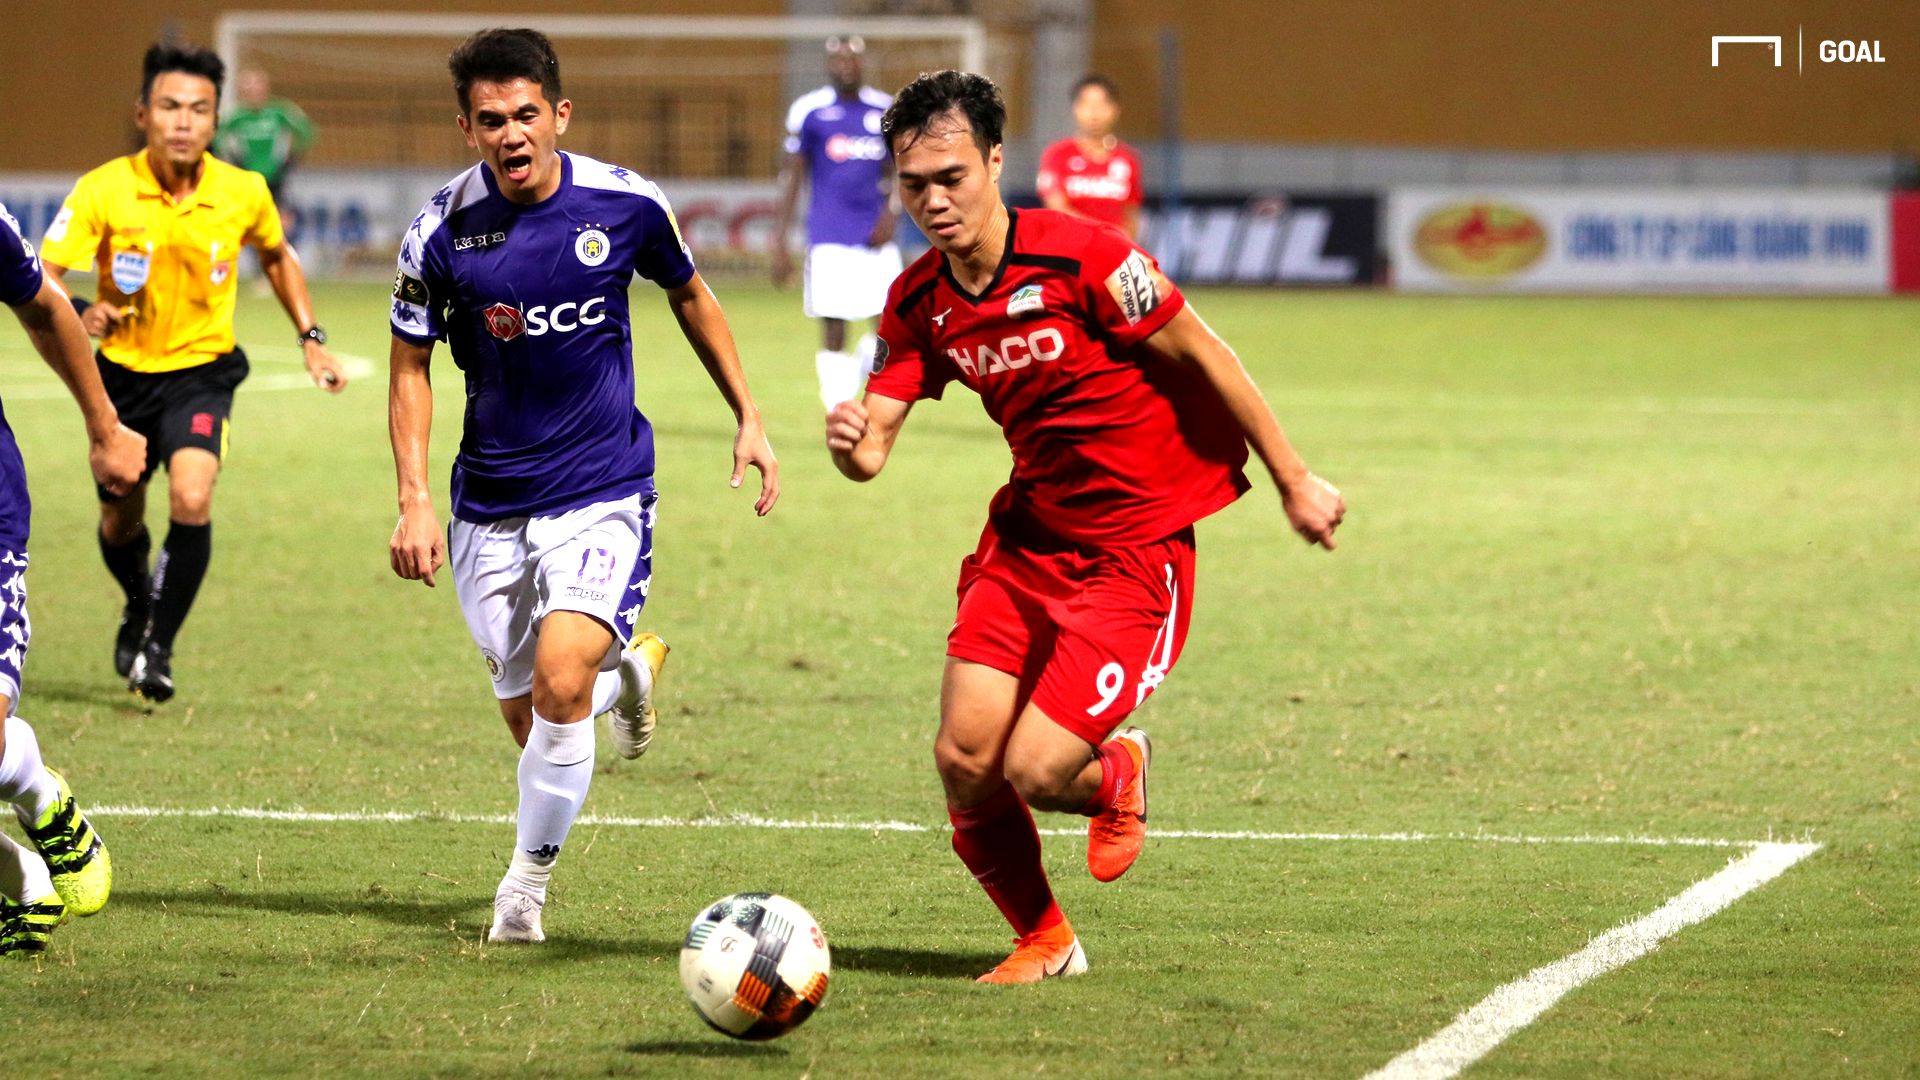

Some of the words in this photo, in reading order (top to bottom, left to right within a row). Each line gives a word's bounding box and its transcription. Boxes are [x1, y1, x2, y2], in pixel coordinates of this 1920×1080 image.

[454, 231, 506, 251] Kappa
[526, 296, 607, 337] SCG
[1086, 661, 1125, 717] 9
